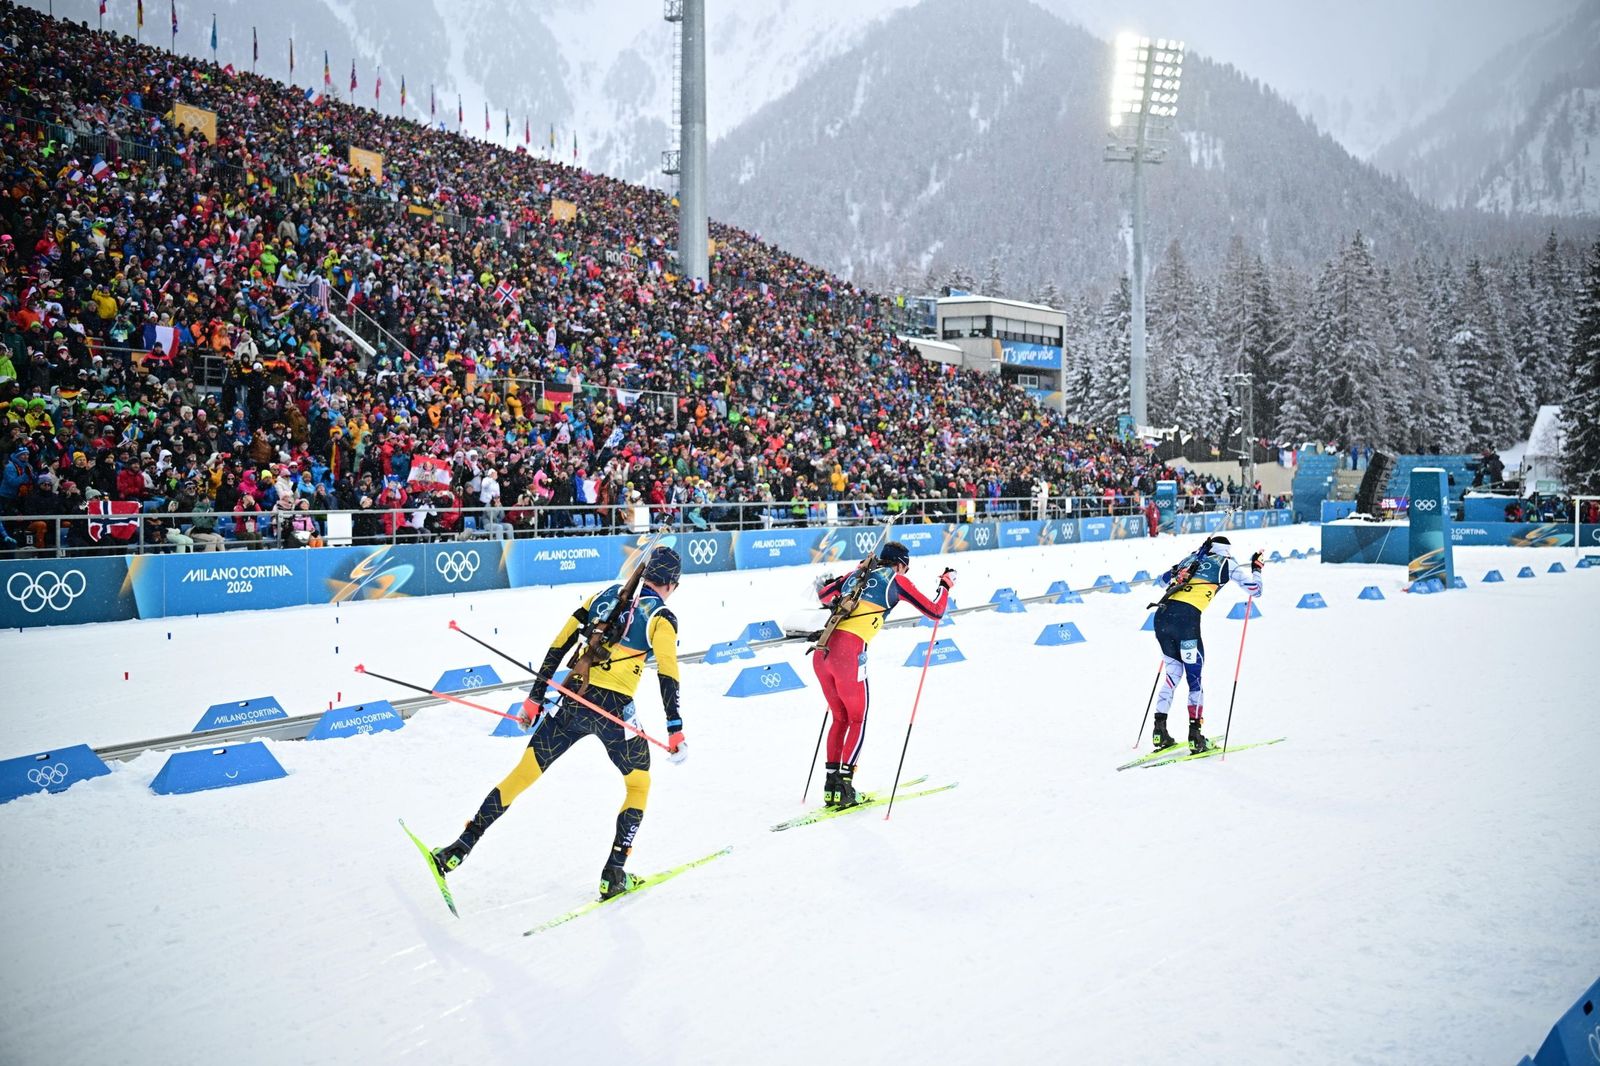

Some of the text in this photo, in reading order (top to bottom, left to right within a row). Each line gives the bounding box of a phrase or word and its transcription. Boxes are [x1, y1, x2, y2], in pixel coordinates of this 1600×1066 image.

[1017, 350, 1037, 365] your
[1038, 346, 1054, 360] vibe
[533, 548, 600, 562] MILANO CORTINA
[559, 560, 576, 570] 2026
[181, 564, 294, 583] MILANO CORTINA
[226, 580, 253, 594] 2026
[1185, 652, 1192, 660] 2
[213, 712, 247, 725] MILANO
[247, 707, 282, 719] CORTINA
[330, 711, 395, 731] MILANO CORTINA
[356, 724, 374, 734] 2026
[623, 825, 640, 847] SWE
